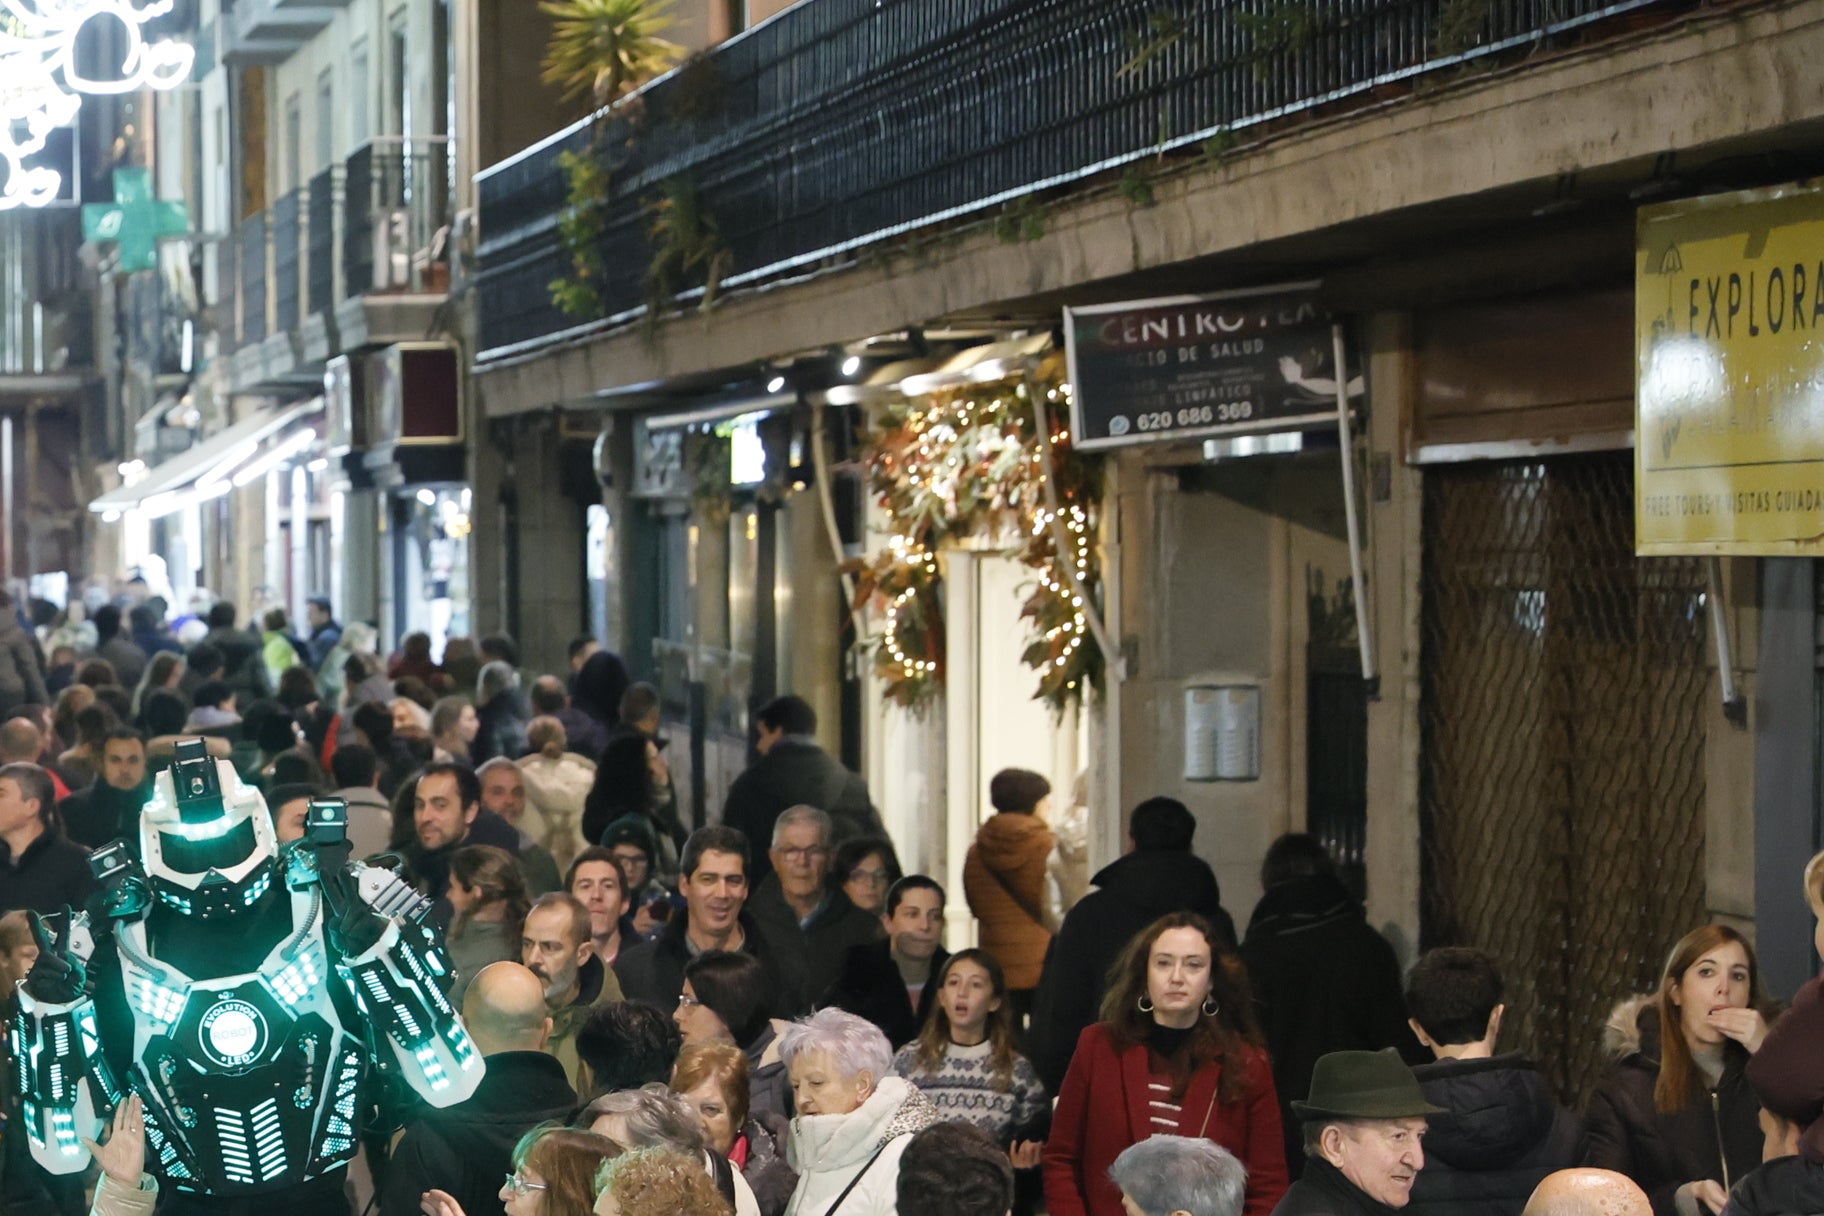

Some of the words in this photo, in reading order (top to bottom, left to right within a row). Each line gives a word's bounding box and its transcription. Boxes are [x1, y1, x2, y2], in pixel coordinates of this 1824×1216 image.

[1689, 261, 1824, 340] EXPLORA
[1178, 345, 1198, 363] DE
[1210, 338, 1264, 359] SALUD
[1137, 411, 1173, 431] 620
[1177, 406, 1213, 426] 686
[1218, 401, 1253, 421] 369
[1645, 495, 1670, 516] FREE
[1675, 494, 1710, 516] TOURS
[1725, 491, 1770, 514] VISITAS
[1776, 489, 1824, 512] GUIADA
[204, 1003, 258, 1029] EVOLUTION
[213, 1026, 253, 1041] ROBOT
[227, 1054, 251, 1066] LED
